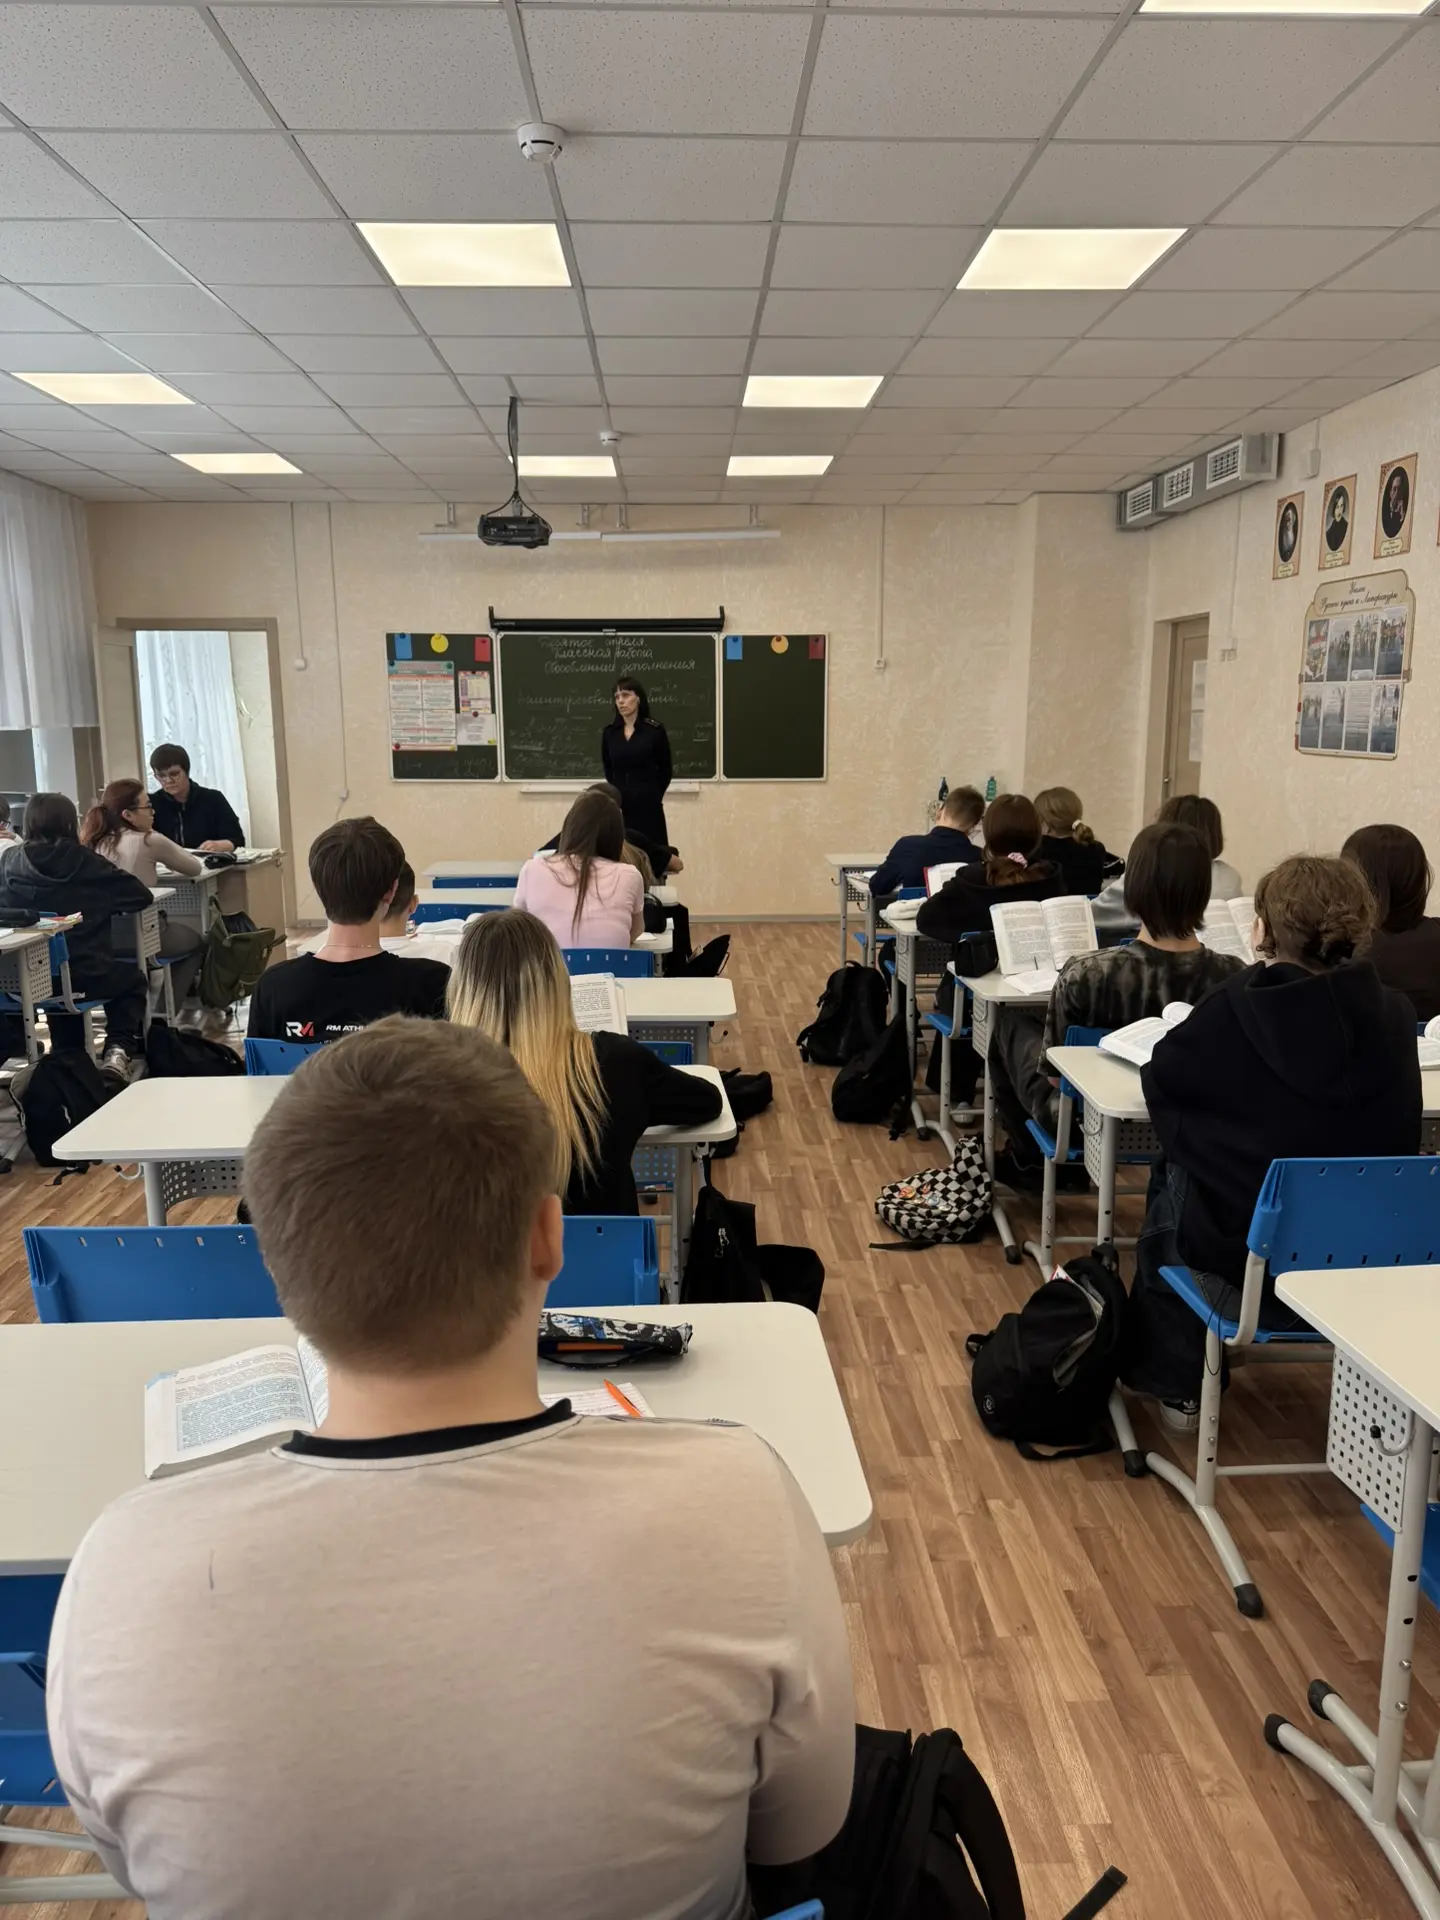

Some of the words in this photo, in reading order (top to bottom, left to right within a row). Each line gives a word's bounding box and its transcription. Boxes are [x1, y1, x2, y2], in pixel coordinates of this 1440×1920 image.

[554, 648, 611, 659] Классная
[613, 647, 653, 663] работа
[326, 1024, 342, 1032] RM
